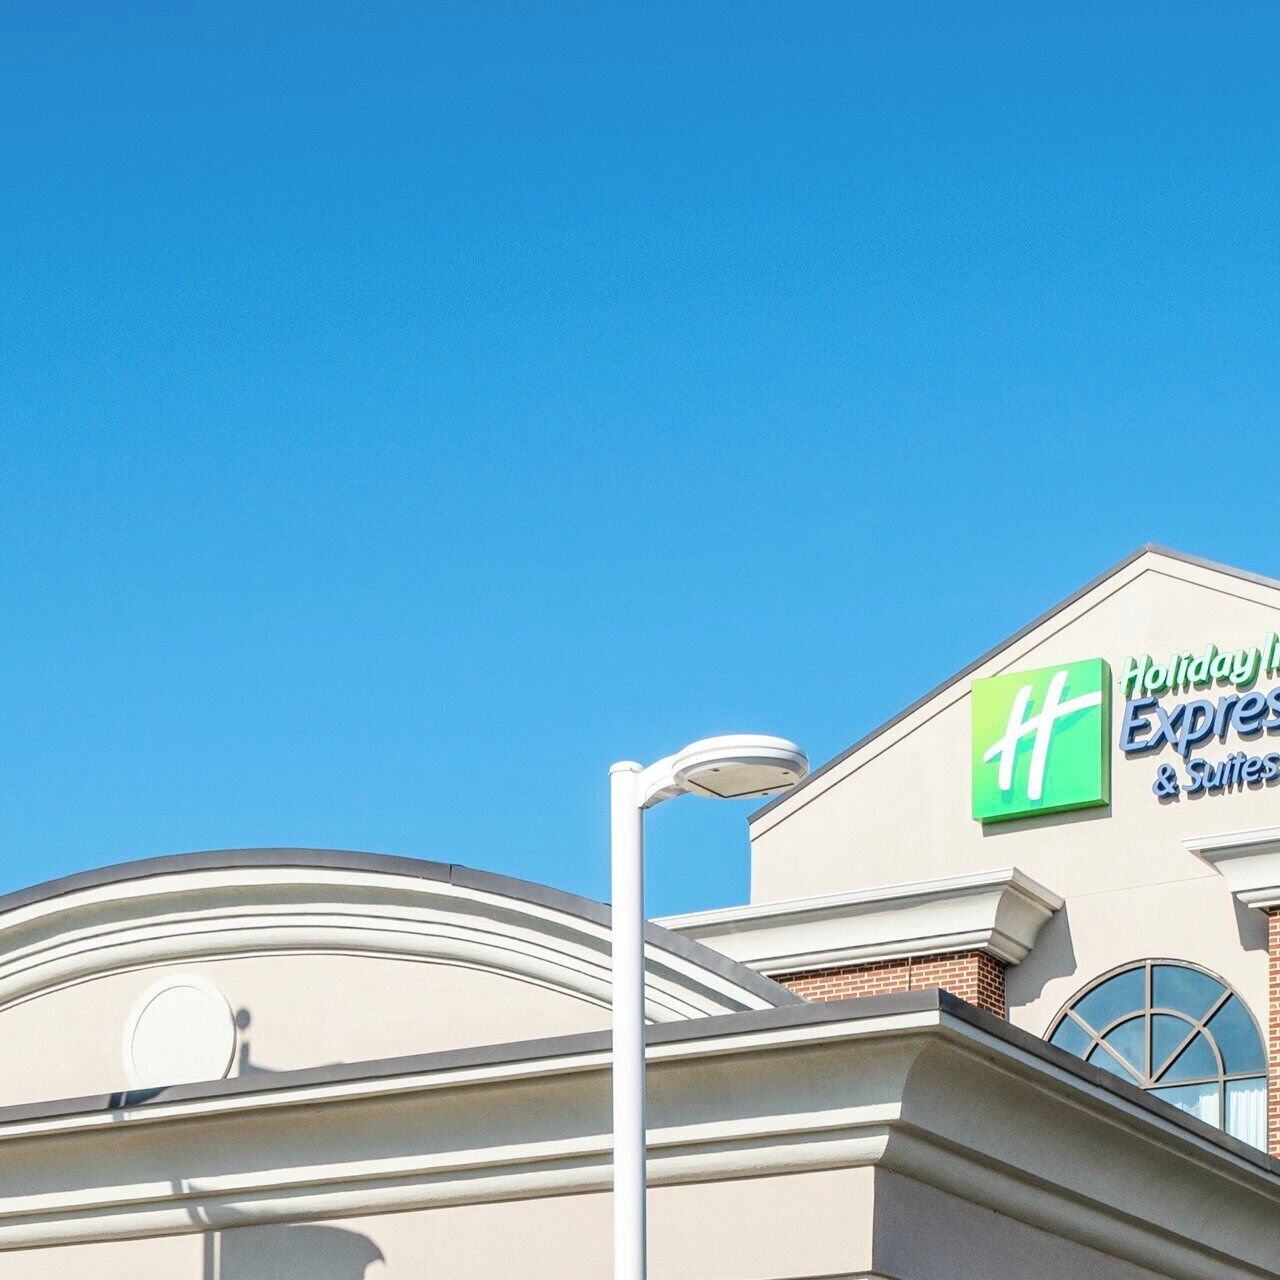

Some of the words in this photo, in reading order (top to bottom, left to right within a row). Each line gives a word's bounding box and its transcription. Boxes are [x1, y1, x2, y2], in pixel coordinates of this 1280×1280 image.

[1118, 643, 1259, 697] Holiday
[1152, 763, 1178, 798] &
[1182, 750, 1280, 791] Suites
